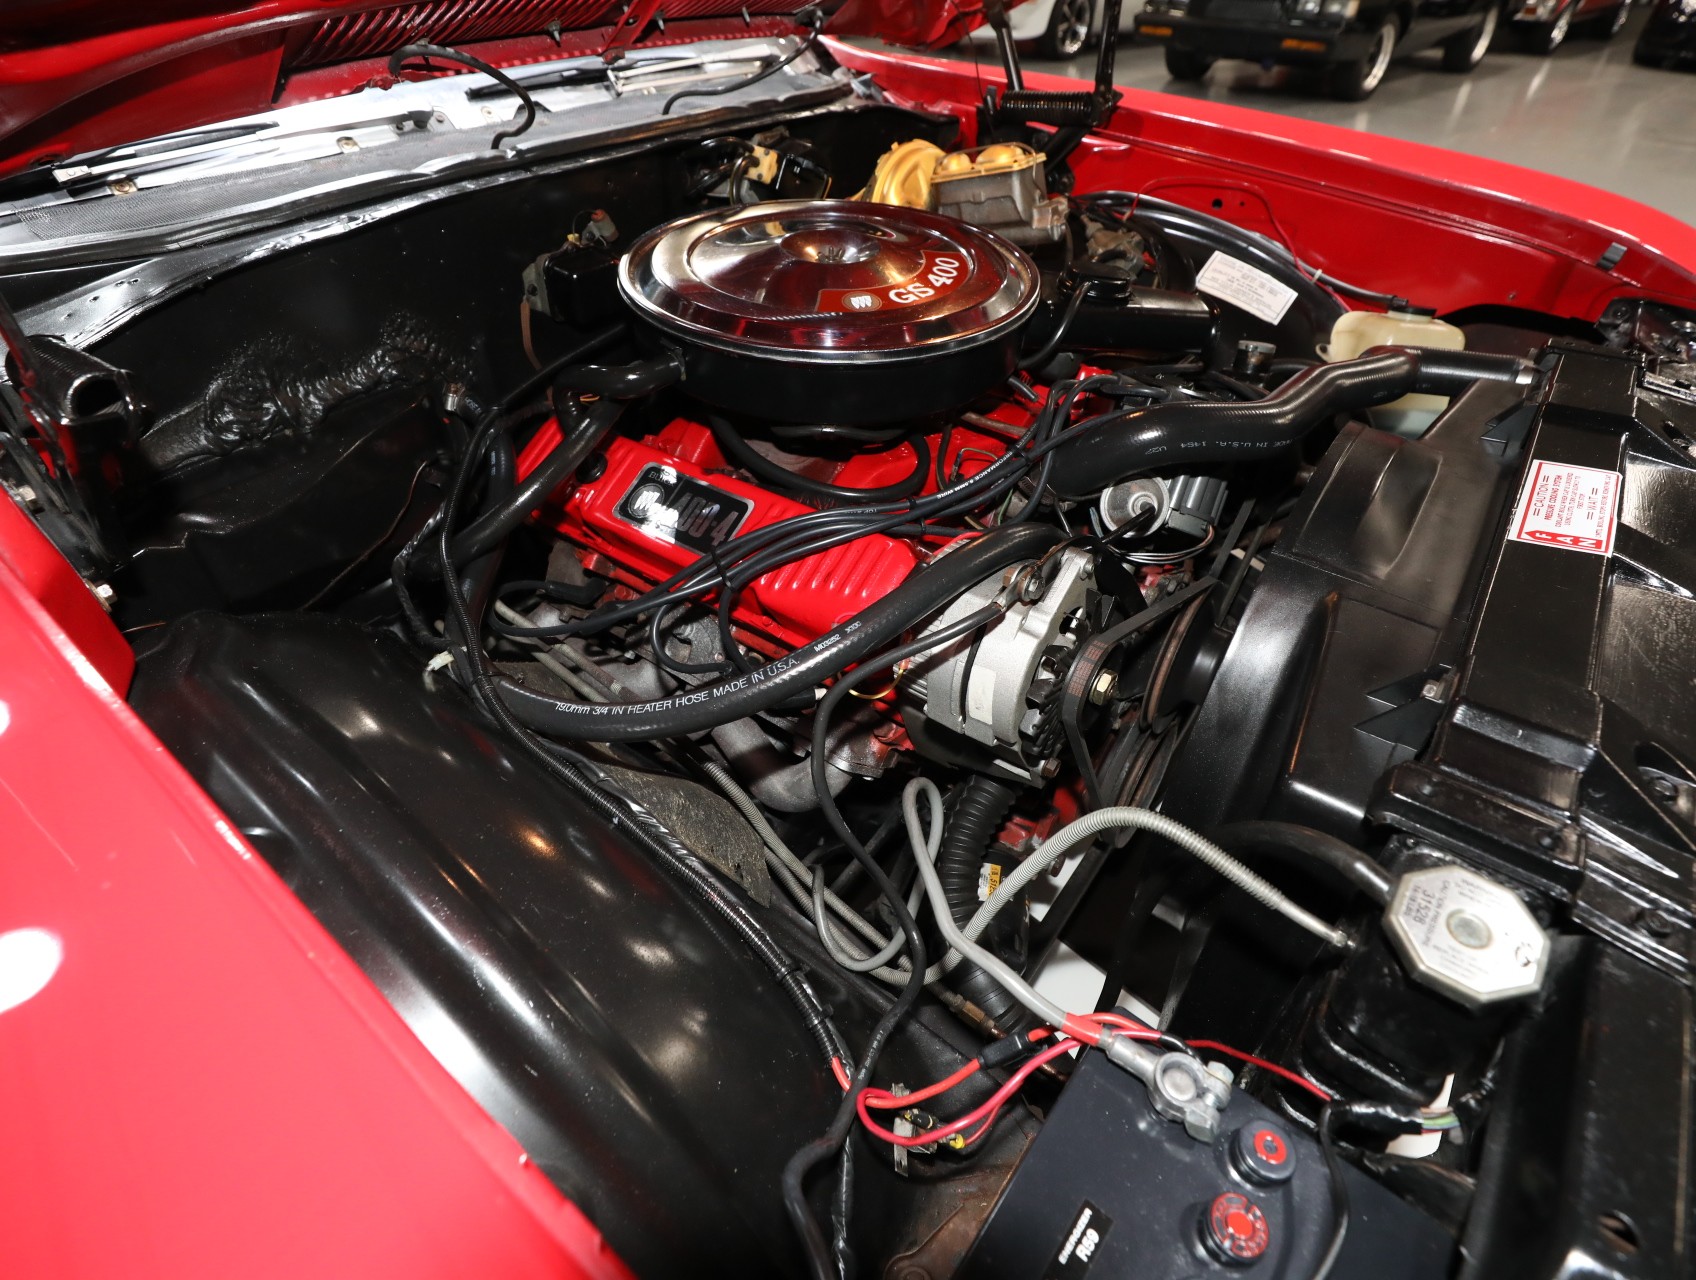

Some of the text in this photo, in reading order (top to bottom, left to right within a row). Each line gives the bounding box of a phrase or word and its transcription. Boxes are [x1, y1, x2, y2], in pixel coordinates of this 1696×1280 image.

[888, 257, 960, 303] GS 400
[974, 451, 1014, 480] ERFORMANCE
[1534, 483, 1549, 508] CAUTION
[1548, 487, 1559, 503] COOLING
[1586, 496, 1598, 510] WAIT
[1535, 532, 1597, 547] FAN
[611, 705, 625, 716] IN
[627, 700, 673, 715] HEATER
[676, 691, 710, 708] HOSE
[713, 677, 748, 698] MADE
[751, 671, 766, 686] IN
[768, 659, 800, 682] U.S.A.
